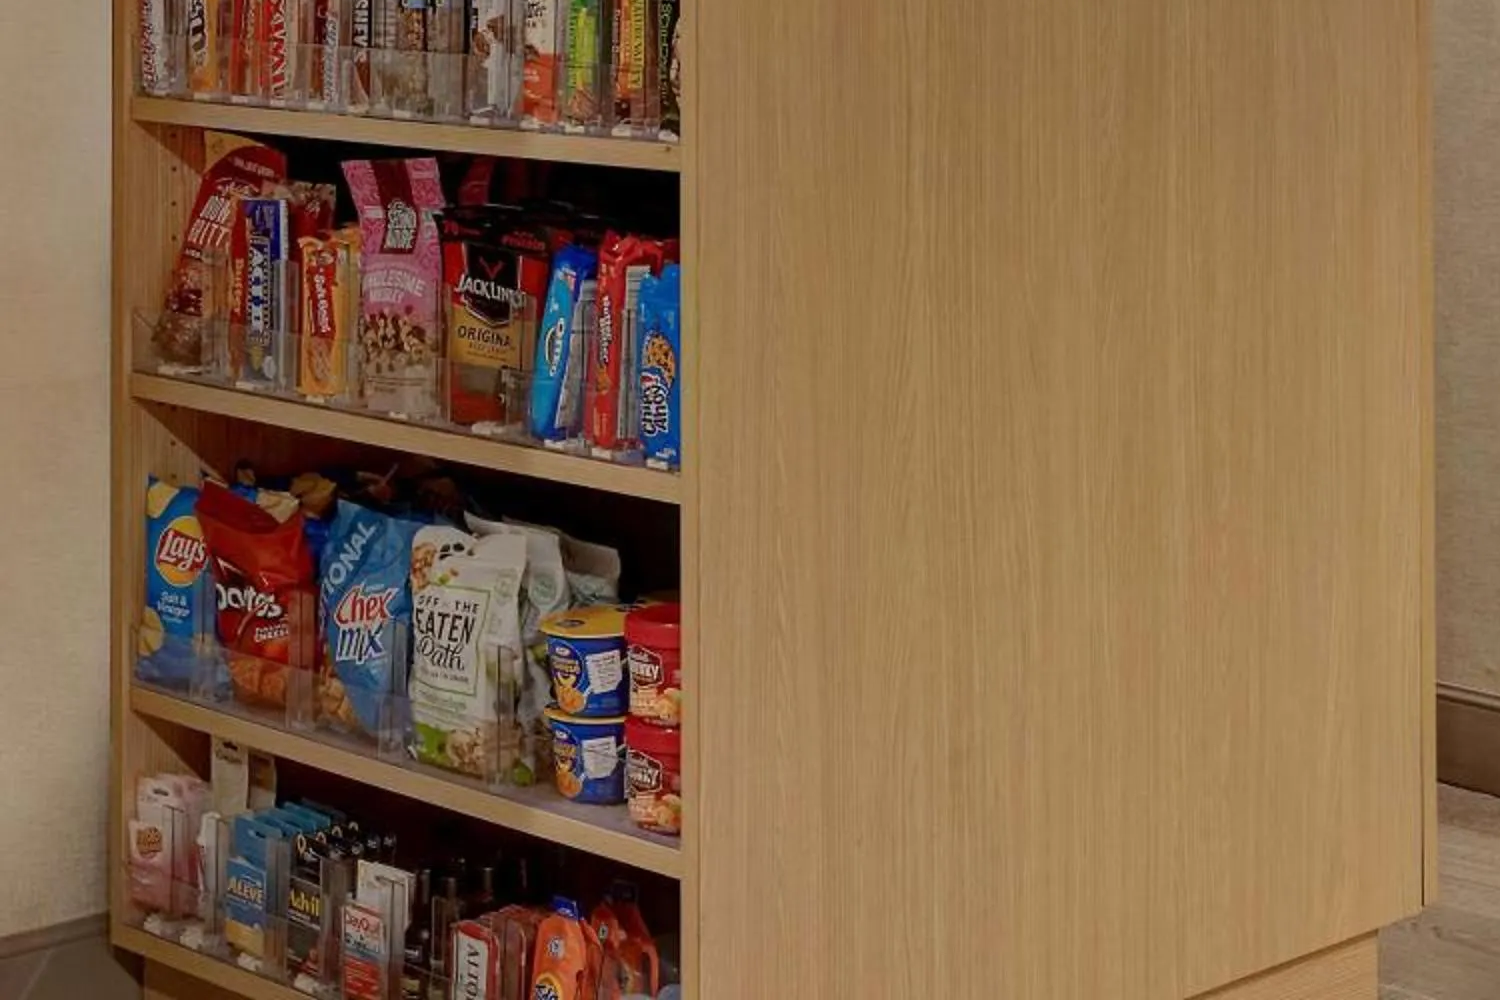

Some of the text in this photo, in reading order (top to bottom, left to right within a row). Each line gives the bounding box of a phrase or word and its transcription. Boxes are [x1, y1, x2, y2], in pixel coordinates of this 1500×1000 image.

[336, 583, 399, 627] Chex
[454, 599, 480, 614] THE
[415, 607, 477, 645] EATEN
[227, 876, 265, 905] ALEVE
[288, 889, 320, 917] Advil
